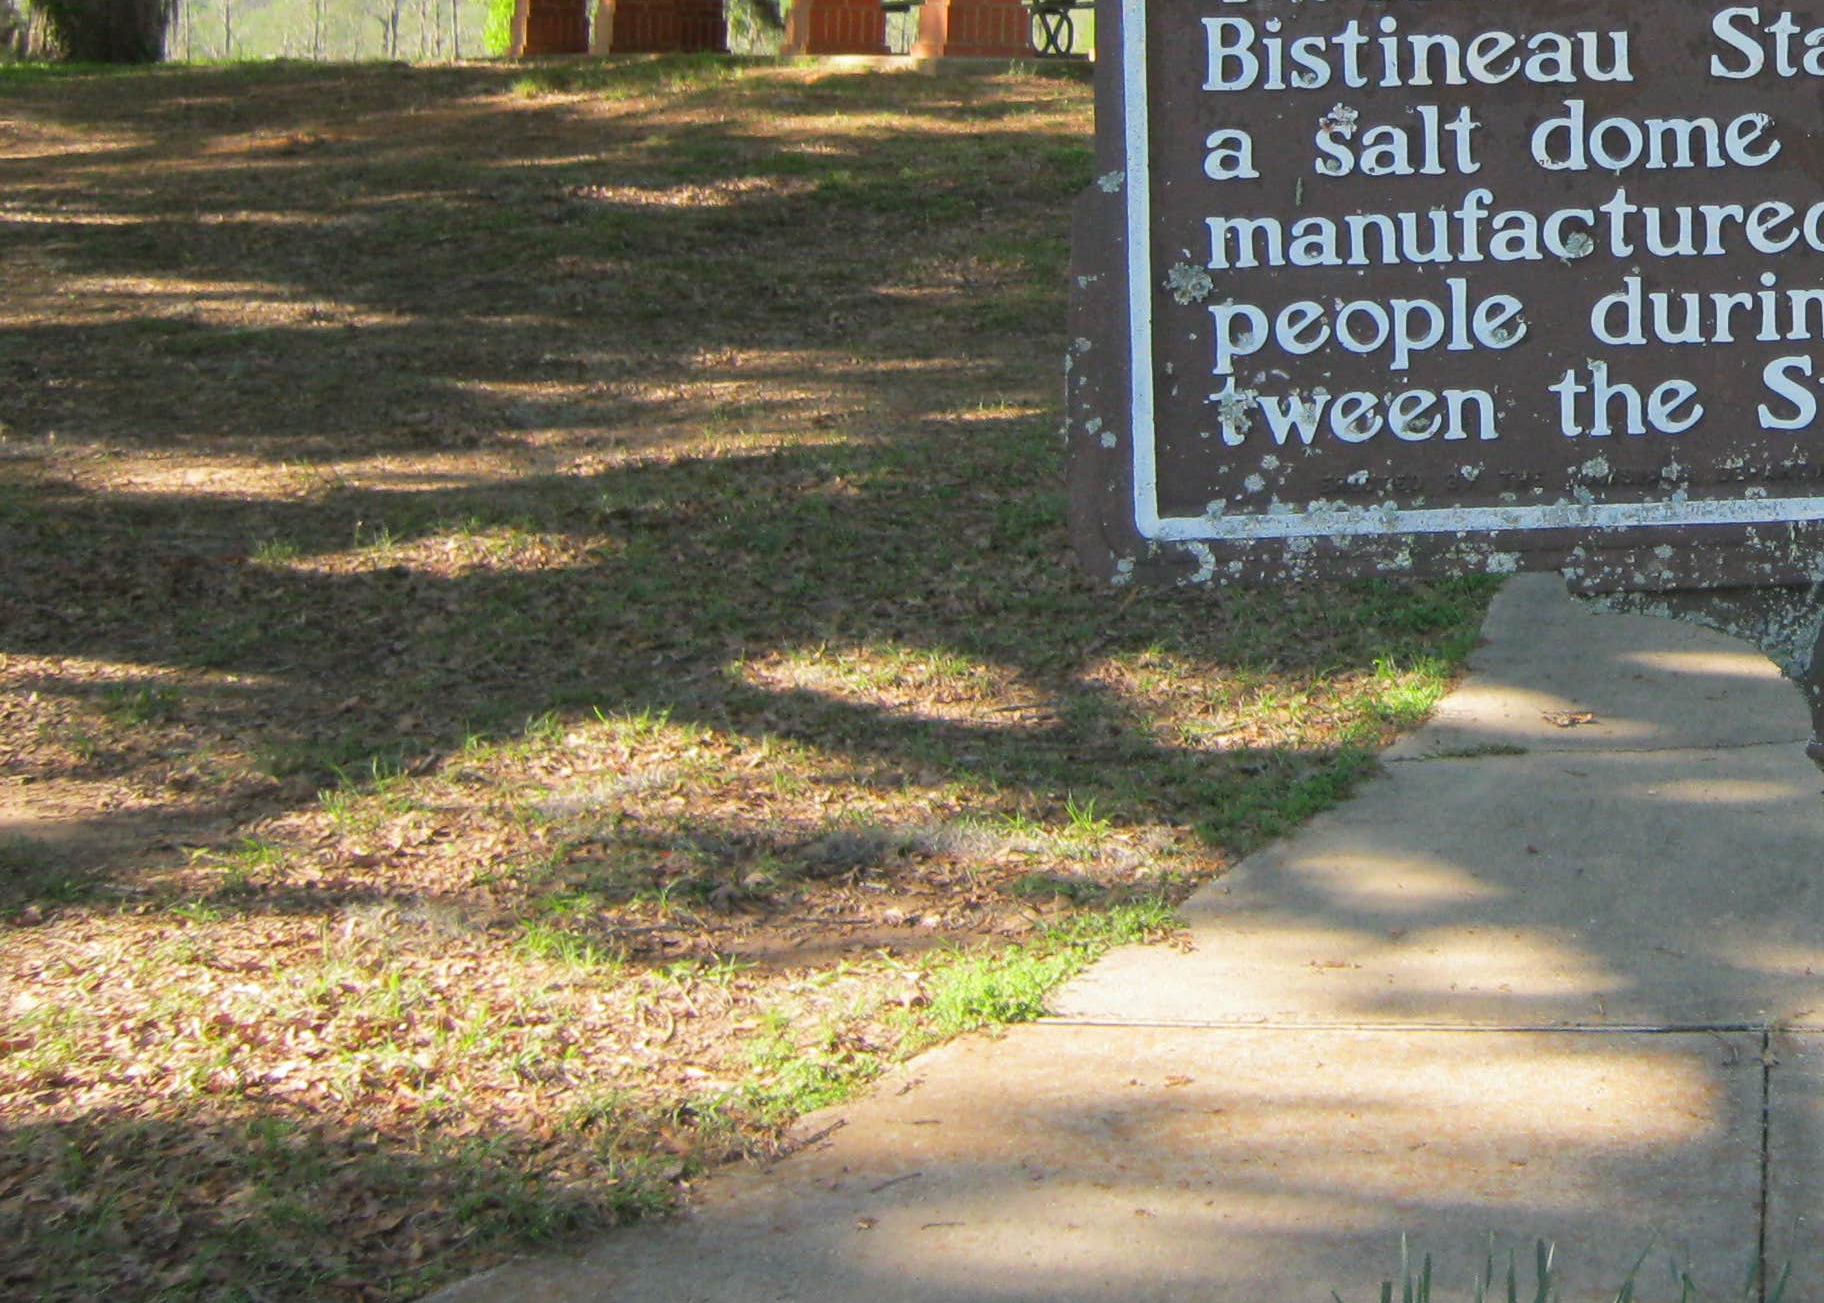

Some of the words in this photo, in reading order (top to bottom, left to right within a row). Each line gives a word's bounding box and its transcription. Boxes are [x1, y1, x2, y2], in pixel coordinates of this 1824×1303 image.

[1200, 16, 1634, 91] Bistineau
[1204, 128, 1260, 180] a
[1315, 102, 1482, 177] salt
[1531, 99, 1781, 176] dome
[1208, 277, 1527, 375] people
[1205, 376, 1499, 446] tween
[1547, 357, 1704, 437] the
